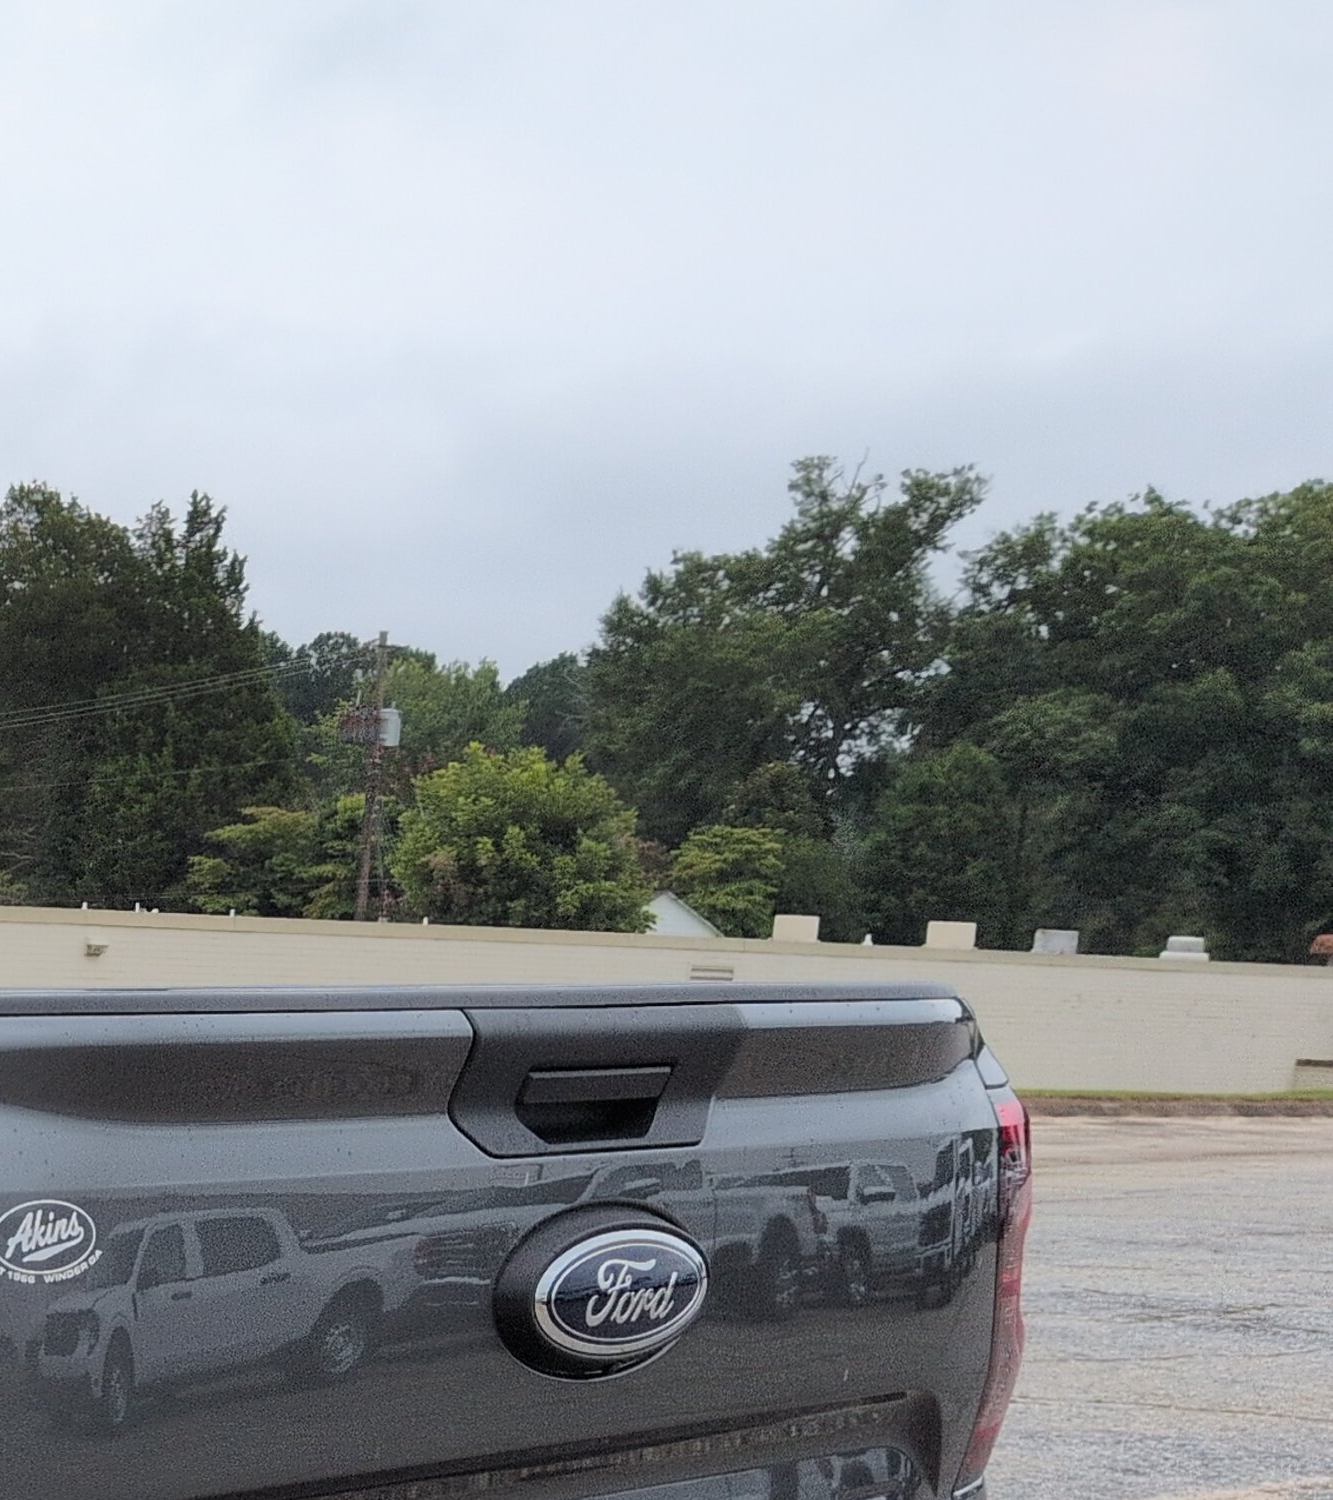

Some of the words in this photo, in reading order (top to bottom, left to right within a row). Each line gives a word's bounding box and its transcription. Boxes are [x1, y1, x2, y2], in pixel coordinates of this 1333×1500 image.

[4, 1209, 84, 1262] Akins
[43, 1261, 89, 1284] WINDER
[88, 1249, 103, 1266] GA
[585, 1258, 679, 1327] Ford
